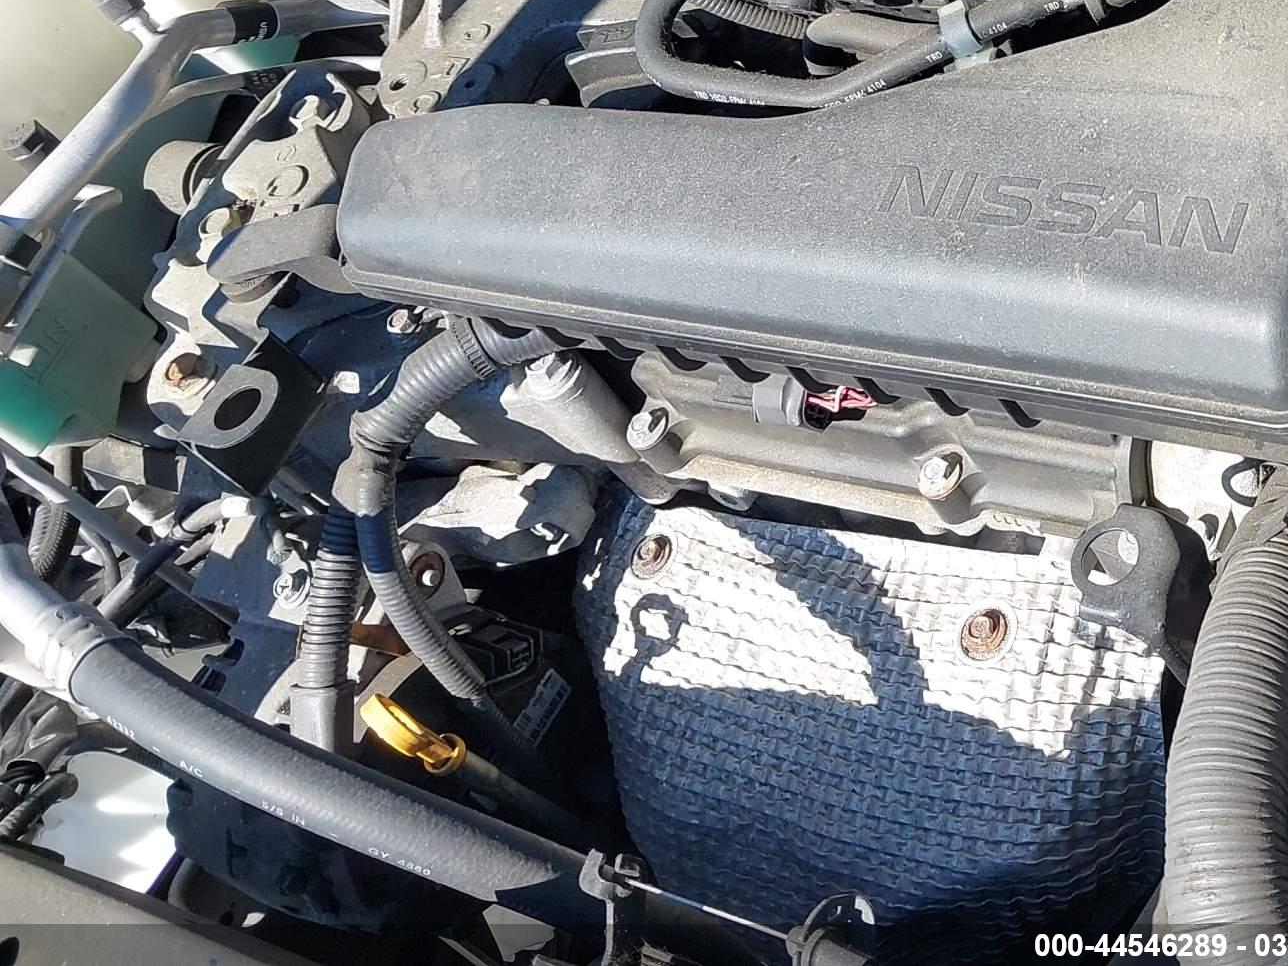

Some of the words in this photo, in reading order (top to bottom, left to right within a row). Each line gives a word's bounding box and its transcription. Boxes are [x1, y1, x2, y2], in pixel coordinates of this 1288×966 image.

[1044, 1, 1060, 13] TRD
[925, 51, 943, 63] TRD
[876, 164, 1250, 255] NISSAN
[180, 760, 203, 778] A/C
[292, 814, 306, 826] IN
[368, 848, 390, 859] GY
